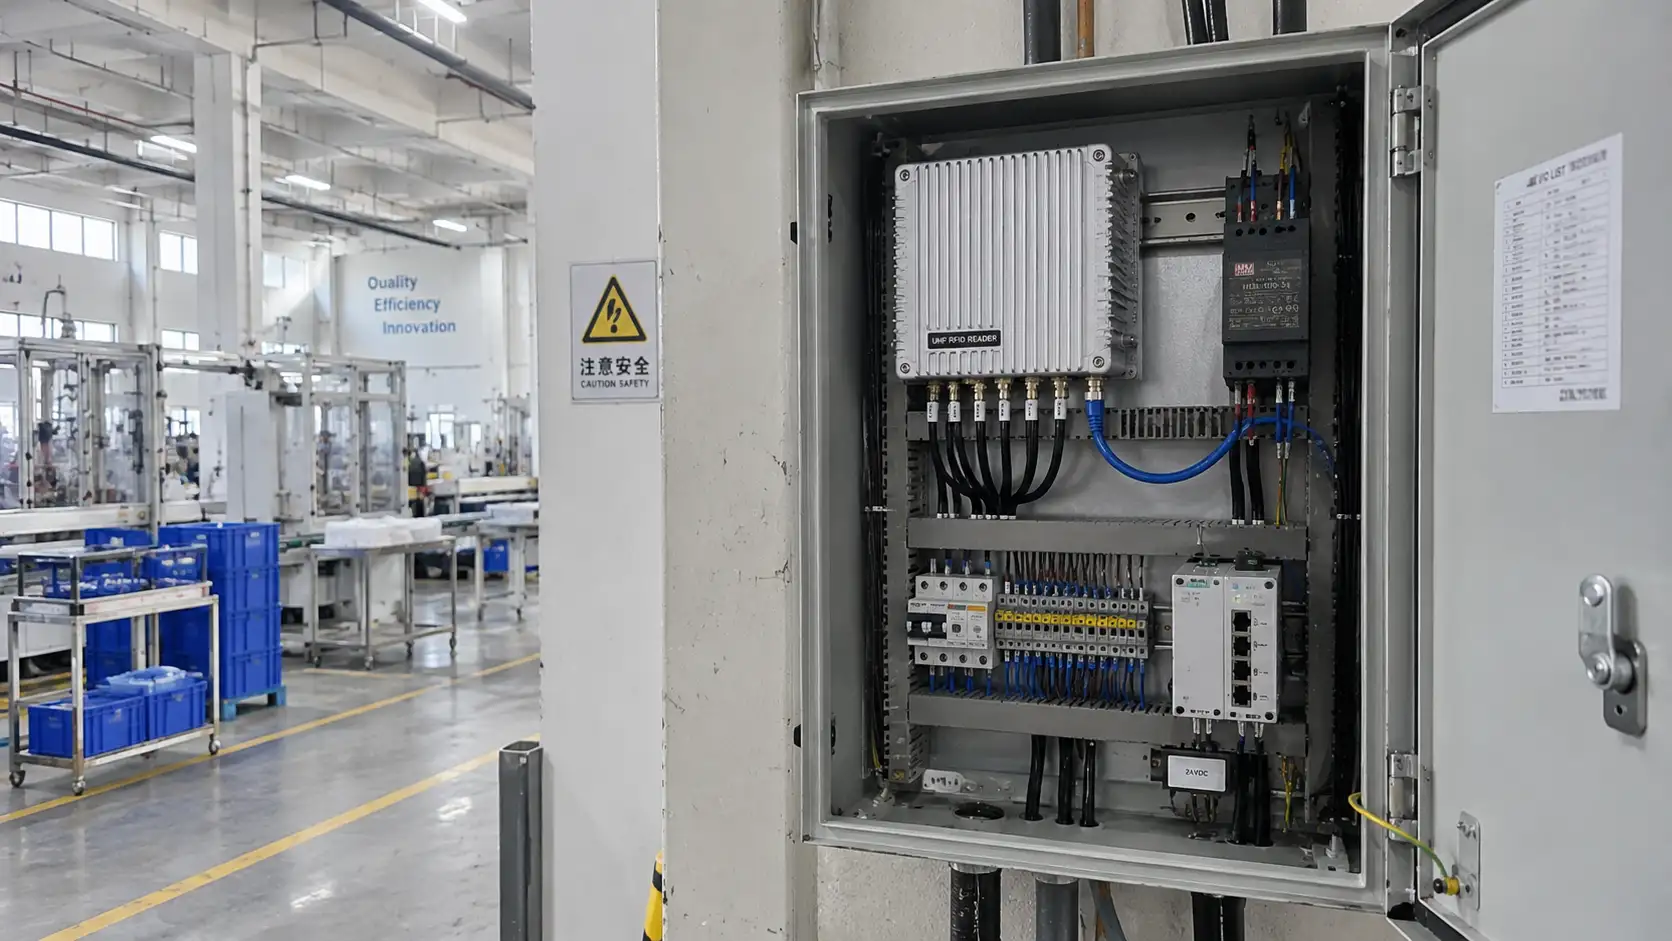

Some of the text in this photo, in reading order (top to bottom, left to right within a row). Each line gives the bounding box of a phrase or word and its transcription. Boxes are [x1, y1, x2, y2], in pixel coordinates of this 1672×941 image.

[1551, 165, 1566, 180] LIST
[367, 274, 418, 292] Quality
[374, 296, 441, 314] Efficiency
[383, 319, 456, 335] Innovation
[931, 335, 997, 345] UHF RFID READER
[580, 356, 649, 376] 注意安全
[581, 379, 649, 389] CAUTION SAFETY
